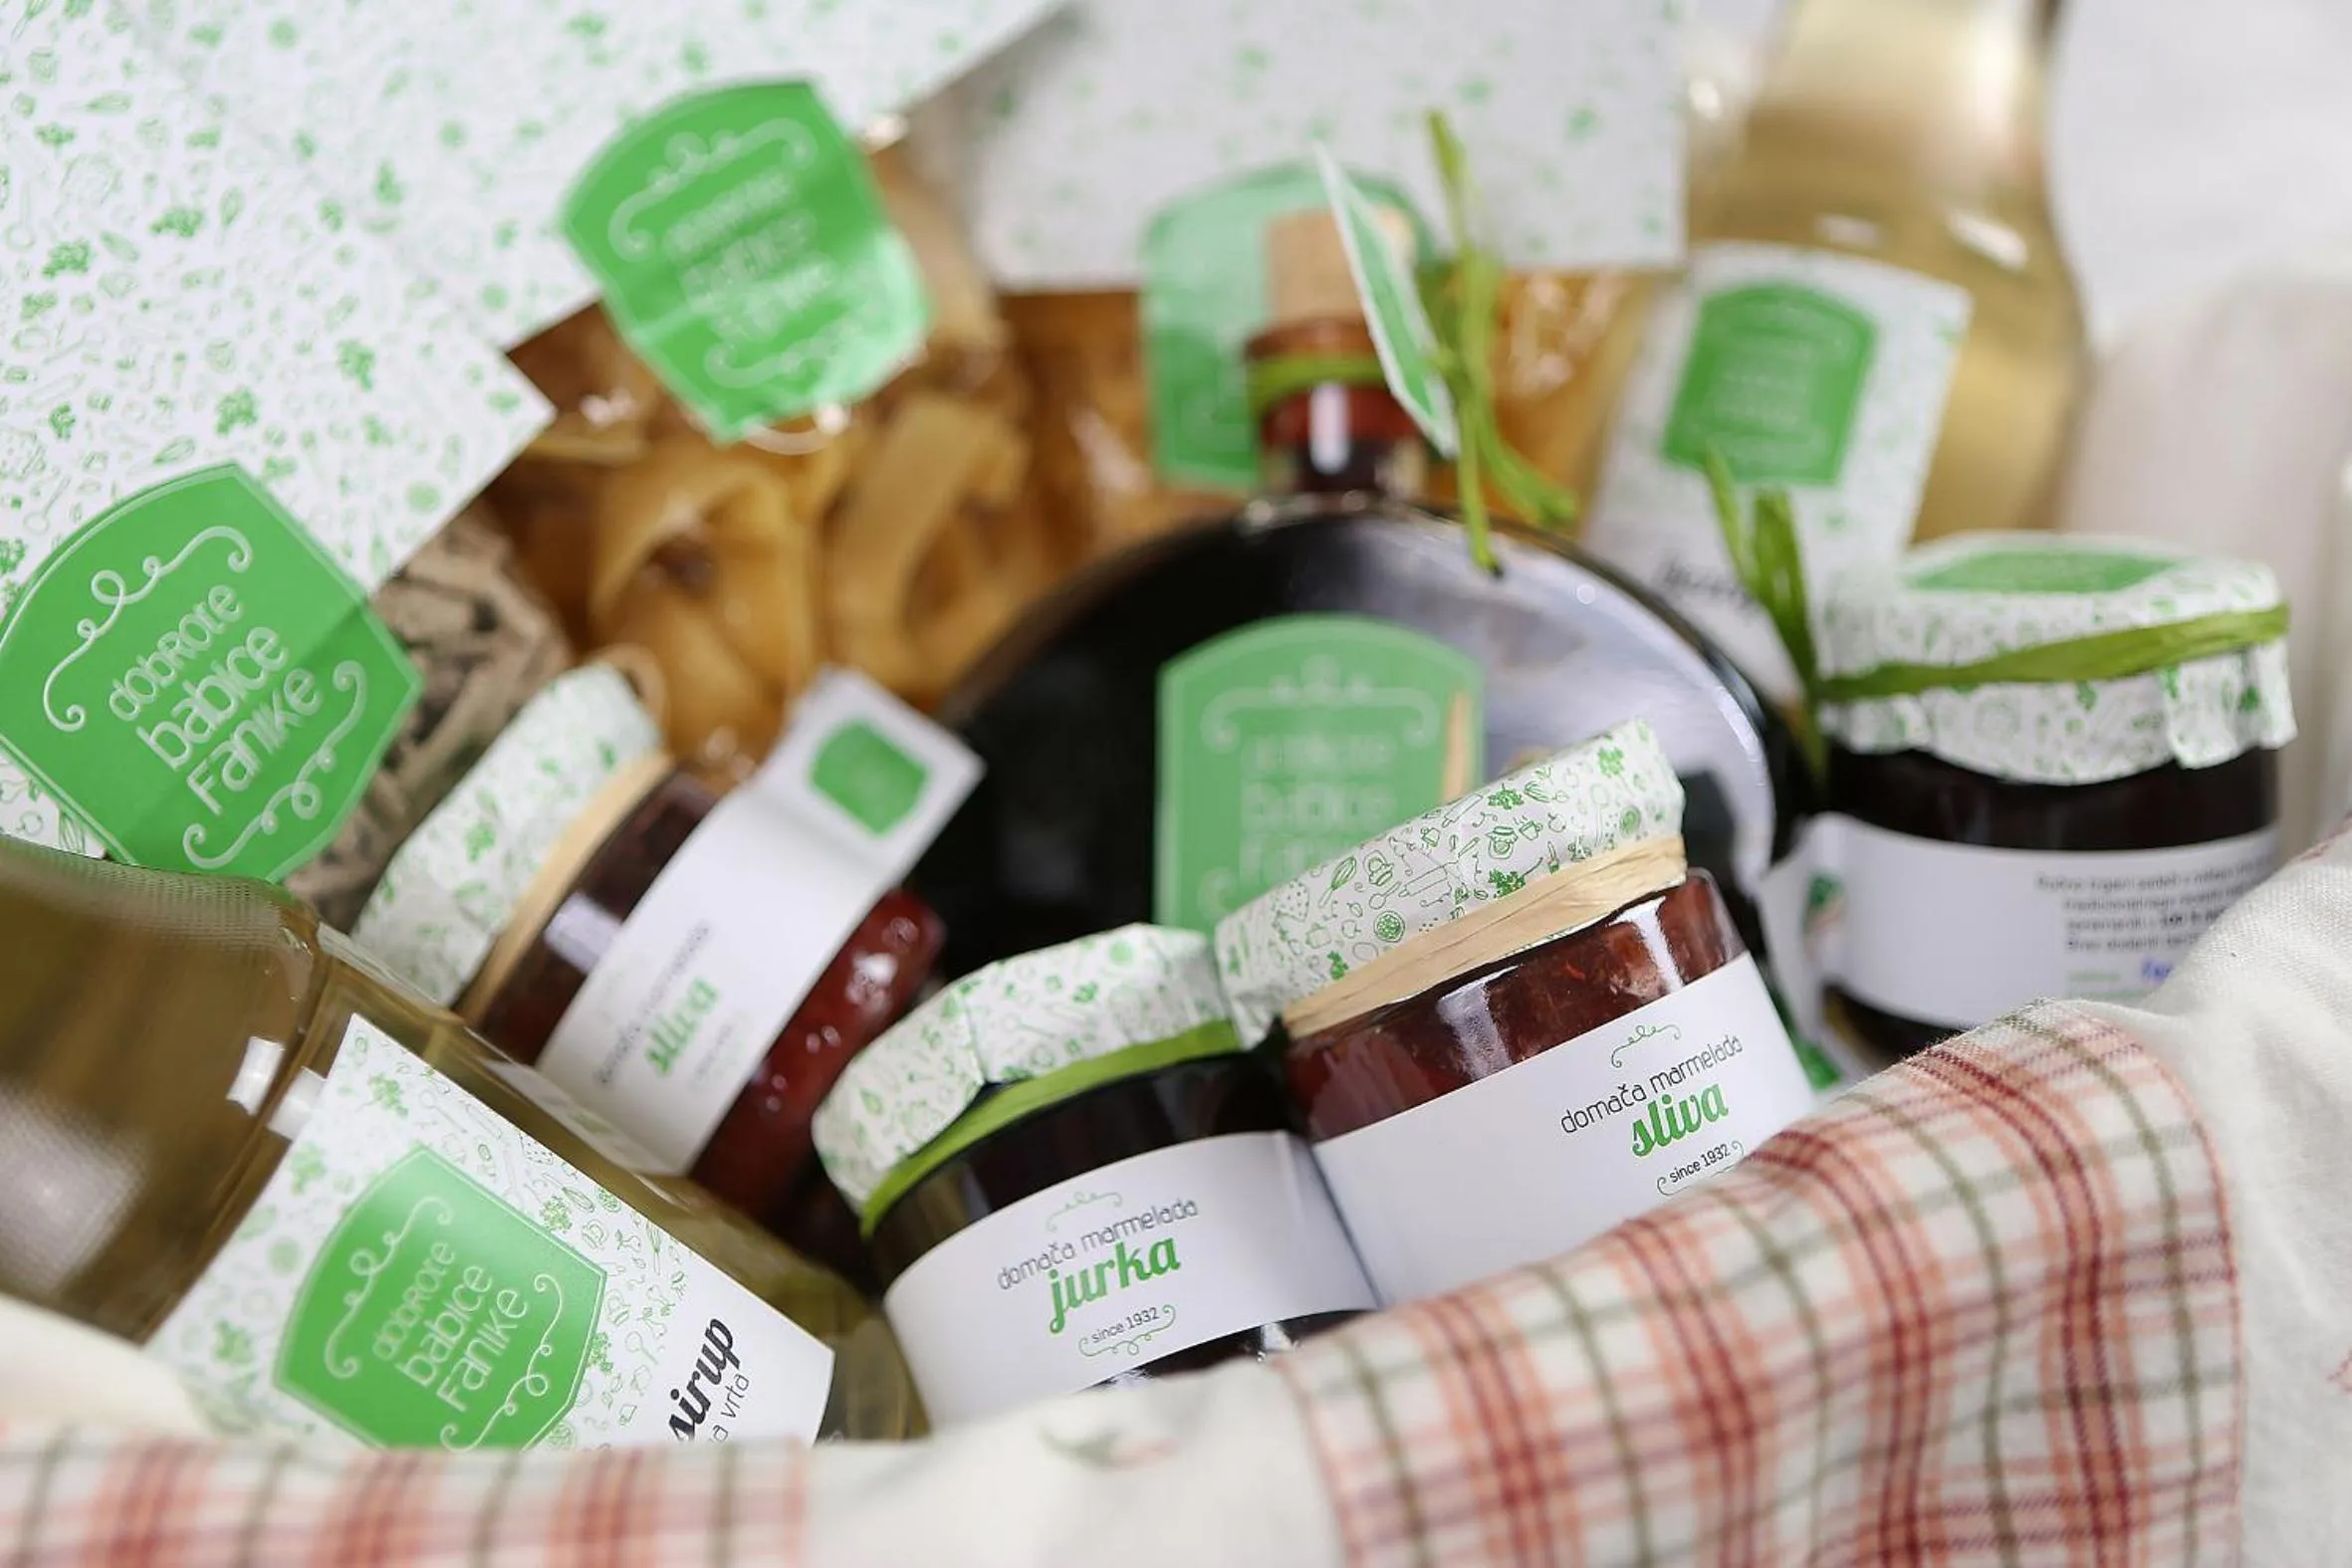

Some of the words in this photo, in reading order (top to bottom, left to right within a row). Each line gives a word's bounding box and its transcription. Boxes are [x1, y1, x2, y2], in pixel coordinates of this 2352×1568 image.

[1560, 1083, 1647, 1134] domača
[1649, 1034, 1744, 1094] marmelada
[1631, 1082, 1730, 1158] sliva
[1669, 1158, 1702, 1184] since
[1701, 1143, 1732, 1168] 1932
[997, 1240, 1075, 1290] domača
[1080, 1198, 1199, 1252] marmelada
[1049, 1236, 1182, 1335] jurka
[1090, 1321, 1125, 1344] since
[1126, 1306, 1160, 1330] 1932
[668, 1318, 741, 1442] sirup
[720, 1373, 750, 1419] vrta
